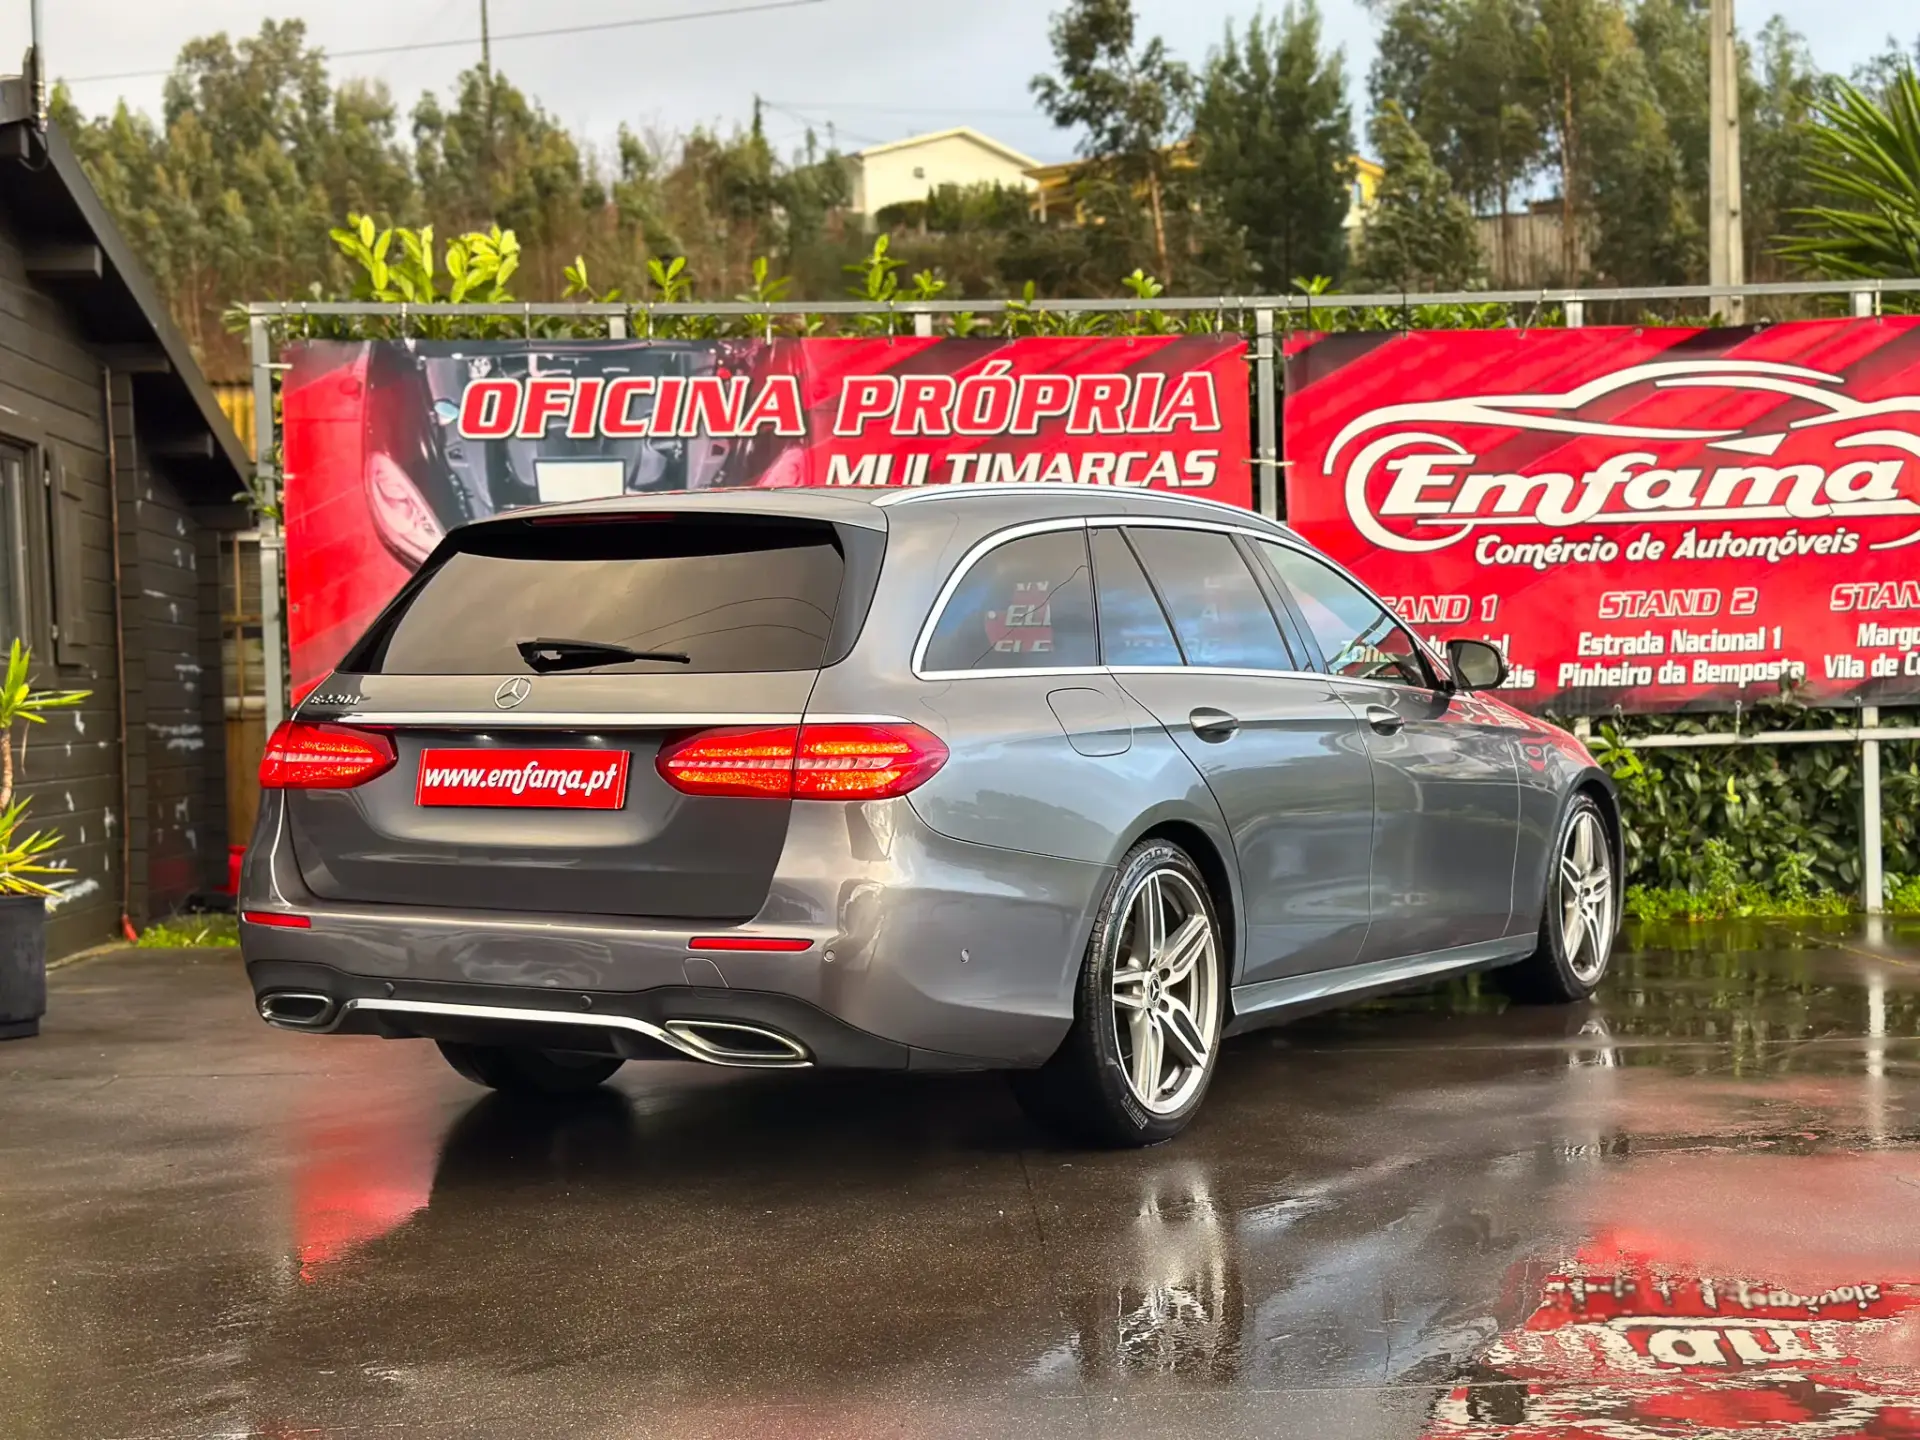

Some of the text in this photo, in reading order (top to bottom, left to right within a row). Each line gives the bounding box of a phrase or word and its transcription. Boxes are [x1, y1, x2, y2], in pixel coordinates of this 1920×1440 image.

[458, 359, 1222, 438] OFICINA PRÓPRIA
[826, 449, 1219, 486] MULTIMARCAS
[1379, 452, 1904, 527] Emfama
[1475, 526, 1860, 569] Comércio de Automóveis
[1384, 594, 1499, 623] AND 1
[1599, 587, 1758, 619] STAND 2
[1577, 626, 1782, 656] Estrada Nacional 1
[1557, 661, 1652, 687] Pinheiro
[1658, 660, 1686, 684] da
[1692, 658, 1805, 688] Bemposta
[1824, 654, 1865, 678] Vila
[1871, 653, 1899, 677] de
[424, 760, 618, 797] www.emfama.pt
